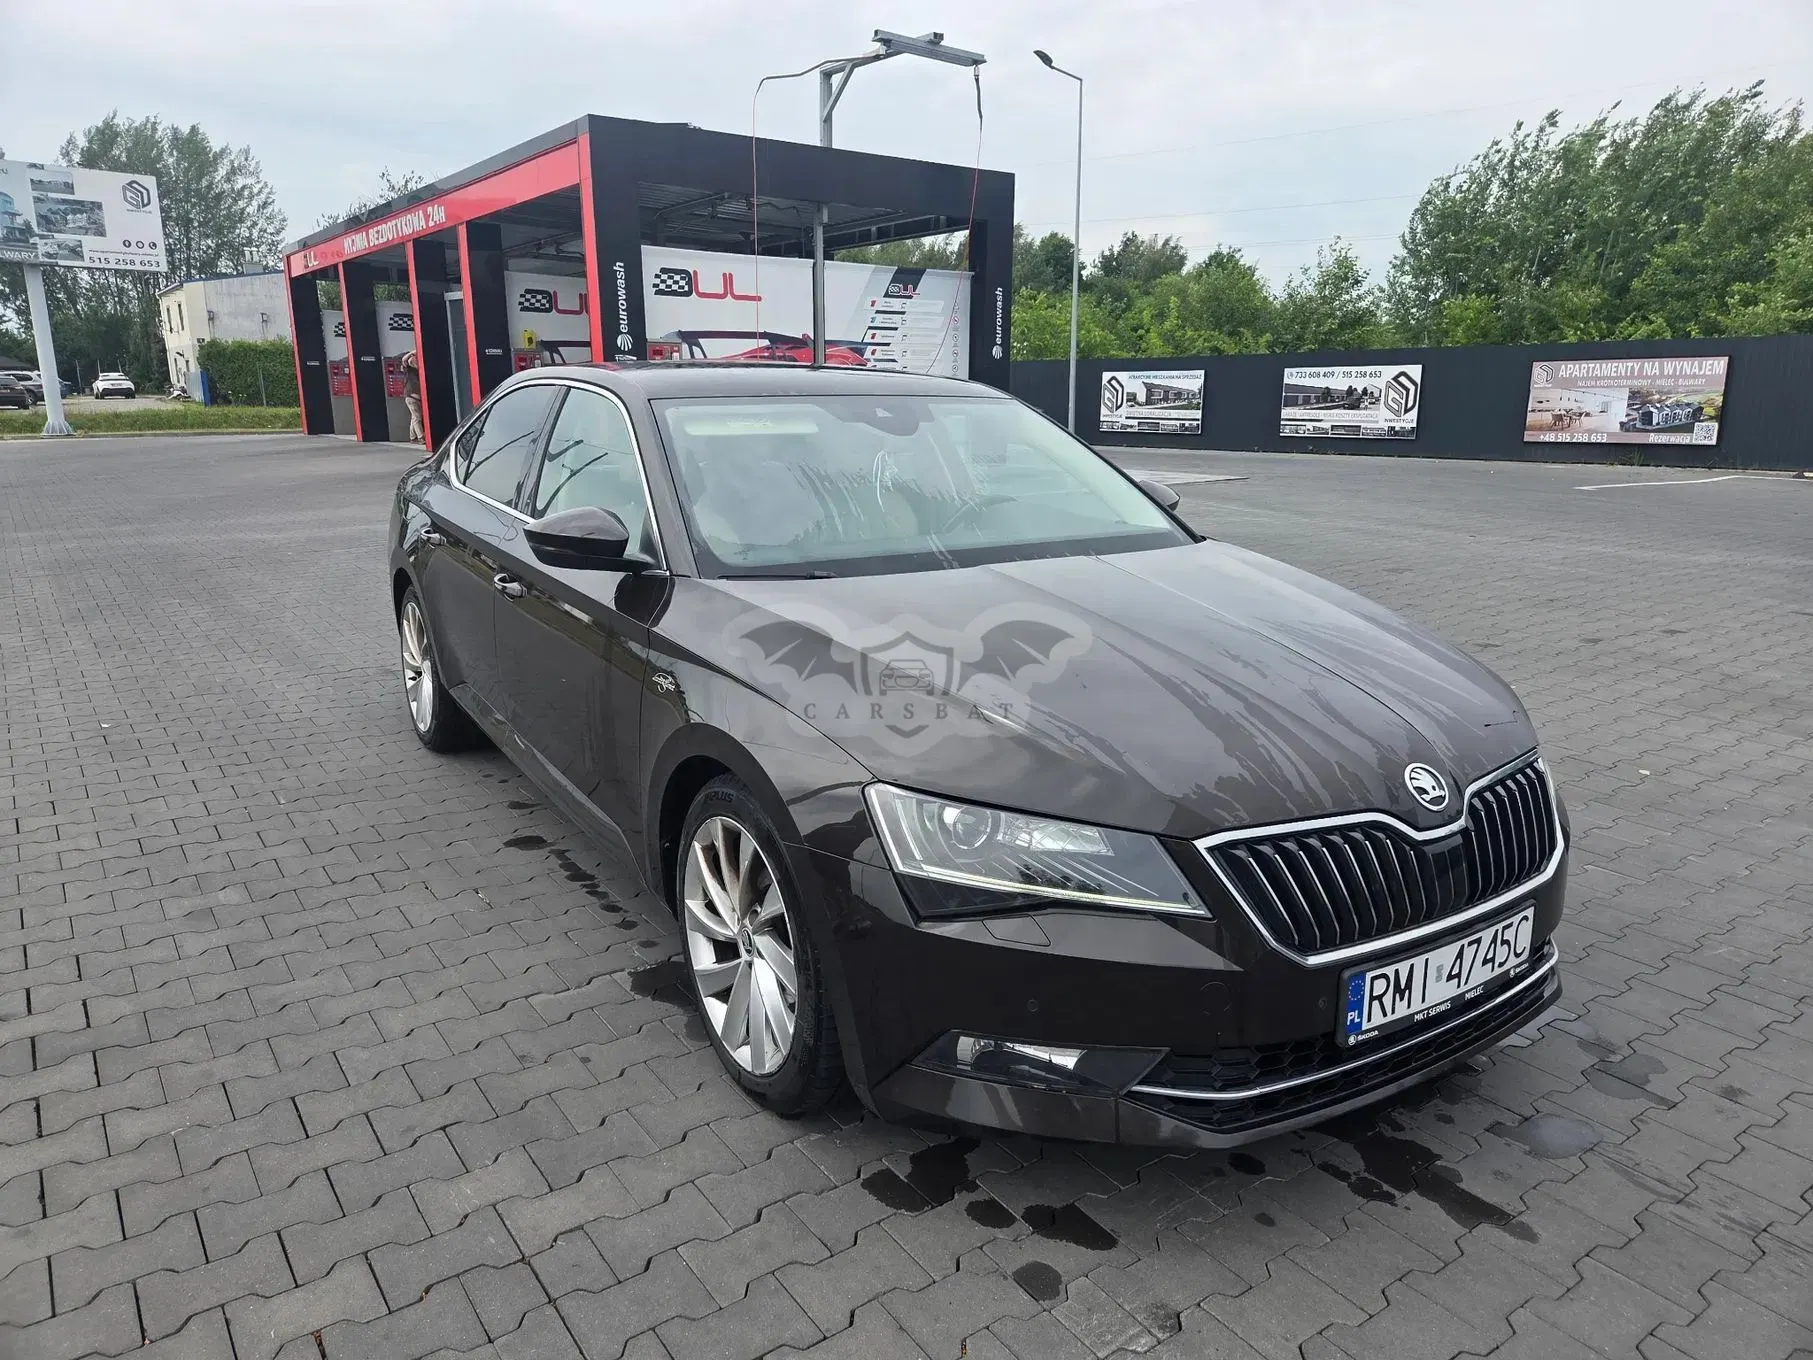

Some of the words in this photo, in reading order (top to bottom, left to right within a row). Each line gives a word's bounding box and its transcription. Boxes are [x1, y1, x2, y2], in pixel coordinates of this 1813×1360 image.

[368, 209, 427, 247] BEZDOTYKOWA
[427, 204, 446, 227] 24H
[88, 256, 111, 265] 515
[114, 258, 136, 267] 258
[139, 259, 161, 268] 653
[613, 261, 628, 333] eurowash
[995, 287, 1003, 345] eurowash
[1294, 371, 1307, 379] 733
[1308, 371, 1321, 379] 608
[1322, 371, 1335, 379] 409
[1341, 371, 1353, 379] 515
[1354, 370, 1368, 378] 258
[1368, 370, 1382, 378] 653
[1558, 362, 1642, 378] APARTAMENTY
[1643, 362, 1660, 376] NA
[1663, 360, 1724, 375] WYNAJEM
[1656, 378, 1674, 386] MIELEC
[1540, 433, 1555, 442] +48
[1557, 433, 1571, 442] 515
[1572, 433, 1589, 442] 258
[1590, 433, 1607, 442] 653
[1649, 433, 1691, 444] Rezerwacja
[1366, 958, 1430, 1024] RMI
[1445, 914, 1530, 990] 4745C
[1464, 985, 1485, 1001] MIELEC
[1346, 1010, 1361, 1026] PL
[1413, 1010, 1429, 1023] MKT
[1428, 1001, 1451, 1018] SERWIS
